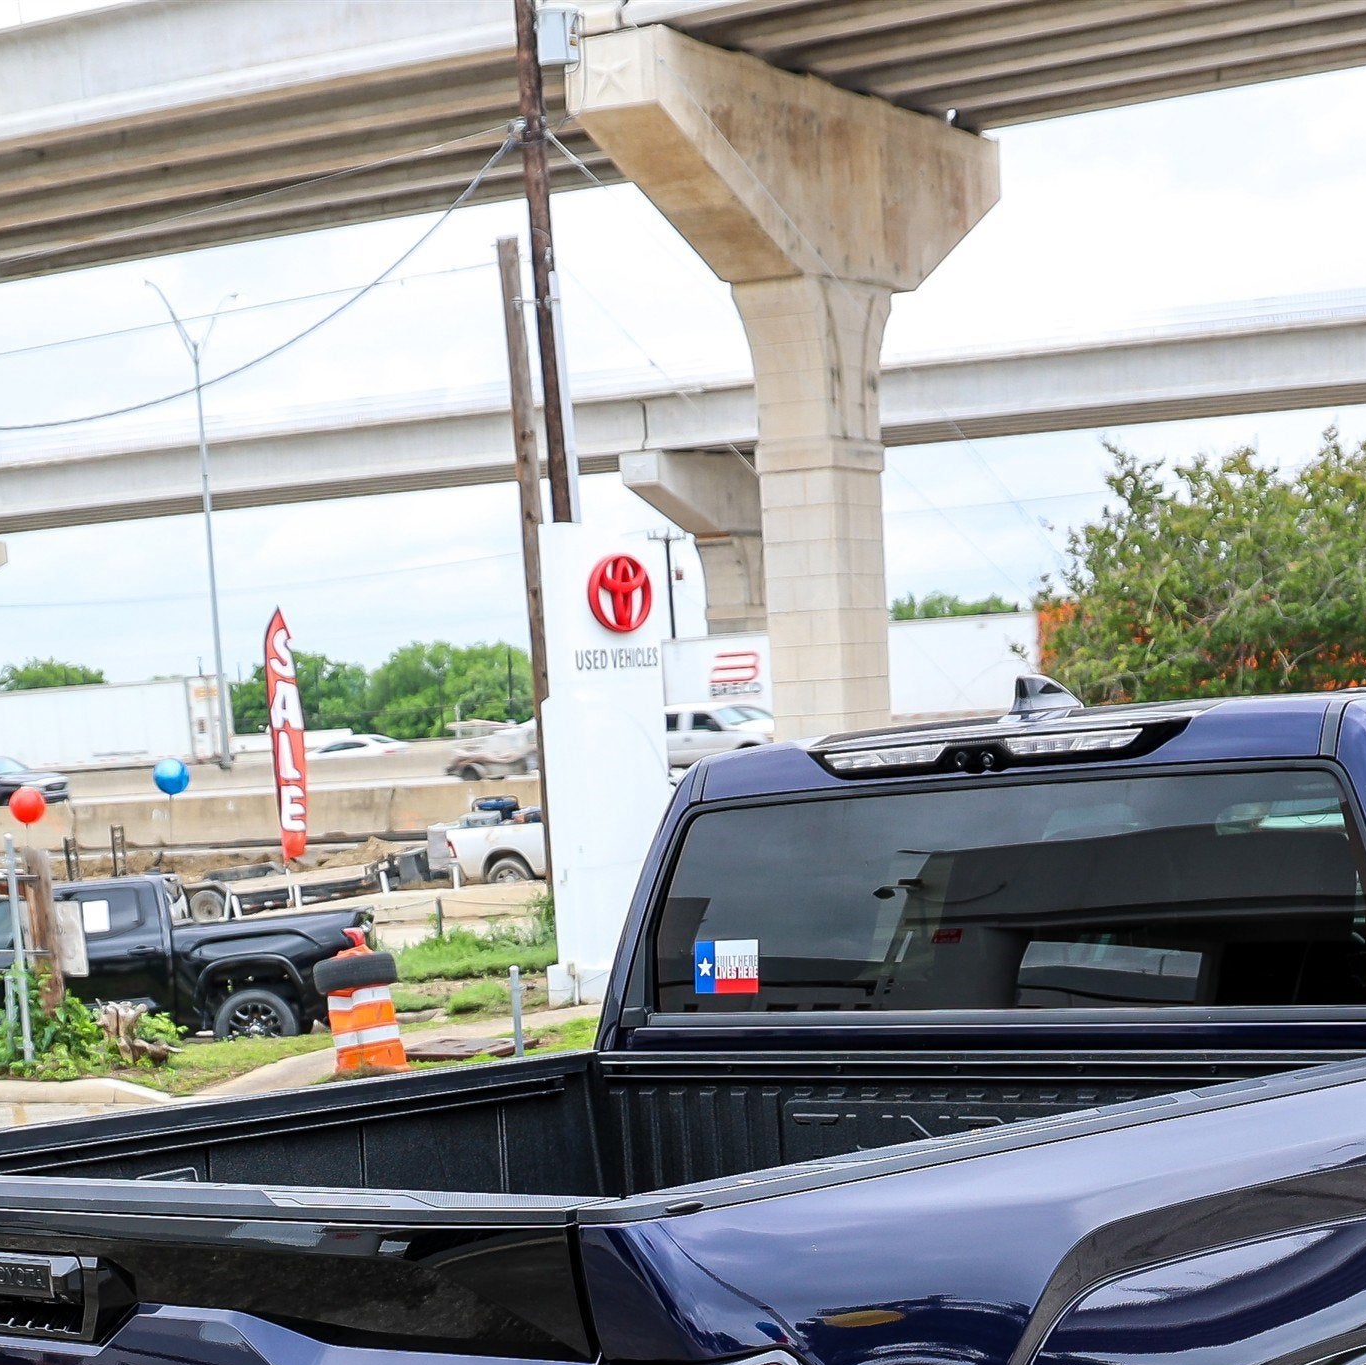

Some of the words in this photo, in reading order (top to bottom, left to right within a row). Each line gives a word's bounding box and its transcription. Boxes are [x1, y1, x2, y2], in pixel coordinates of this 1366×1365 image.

[575, 648, 608, 671] USED
[611, 646, 659, 669] VEHICLES
[269, 628, 307, 832] SALE
[738, 954, 758, 966] HERE
[715, 966, 737, 979] LIVES
[738, 966, 759, 979] HERE
